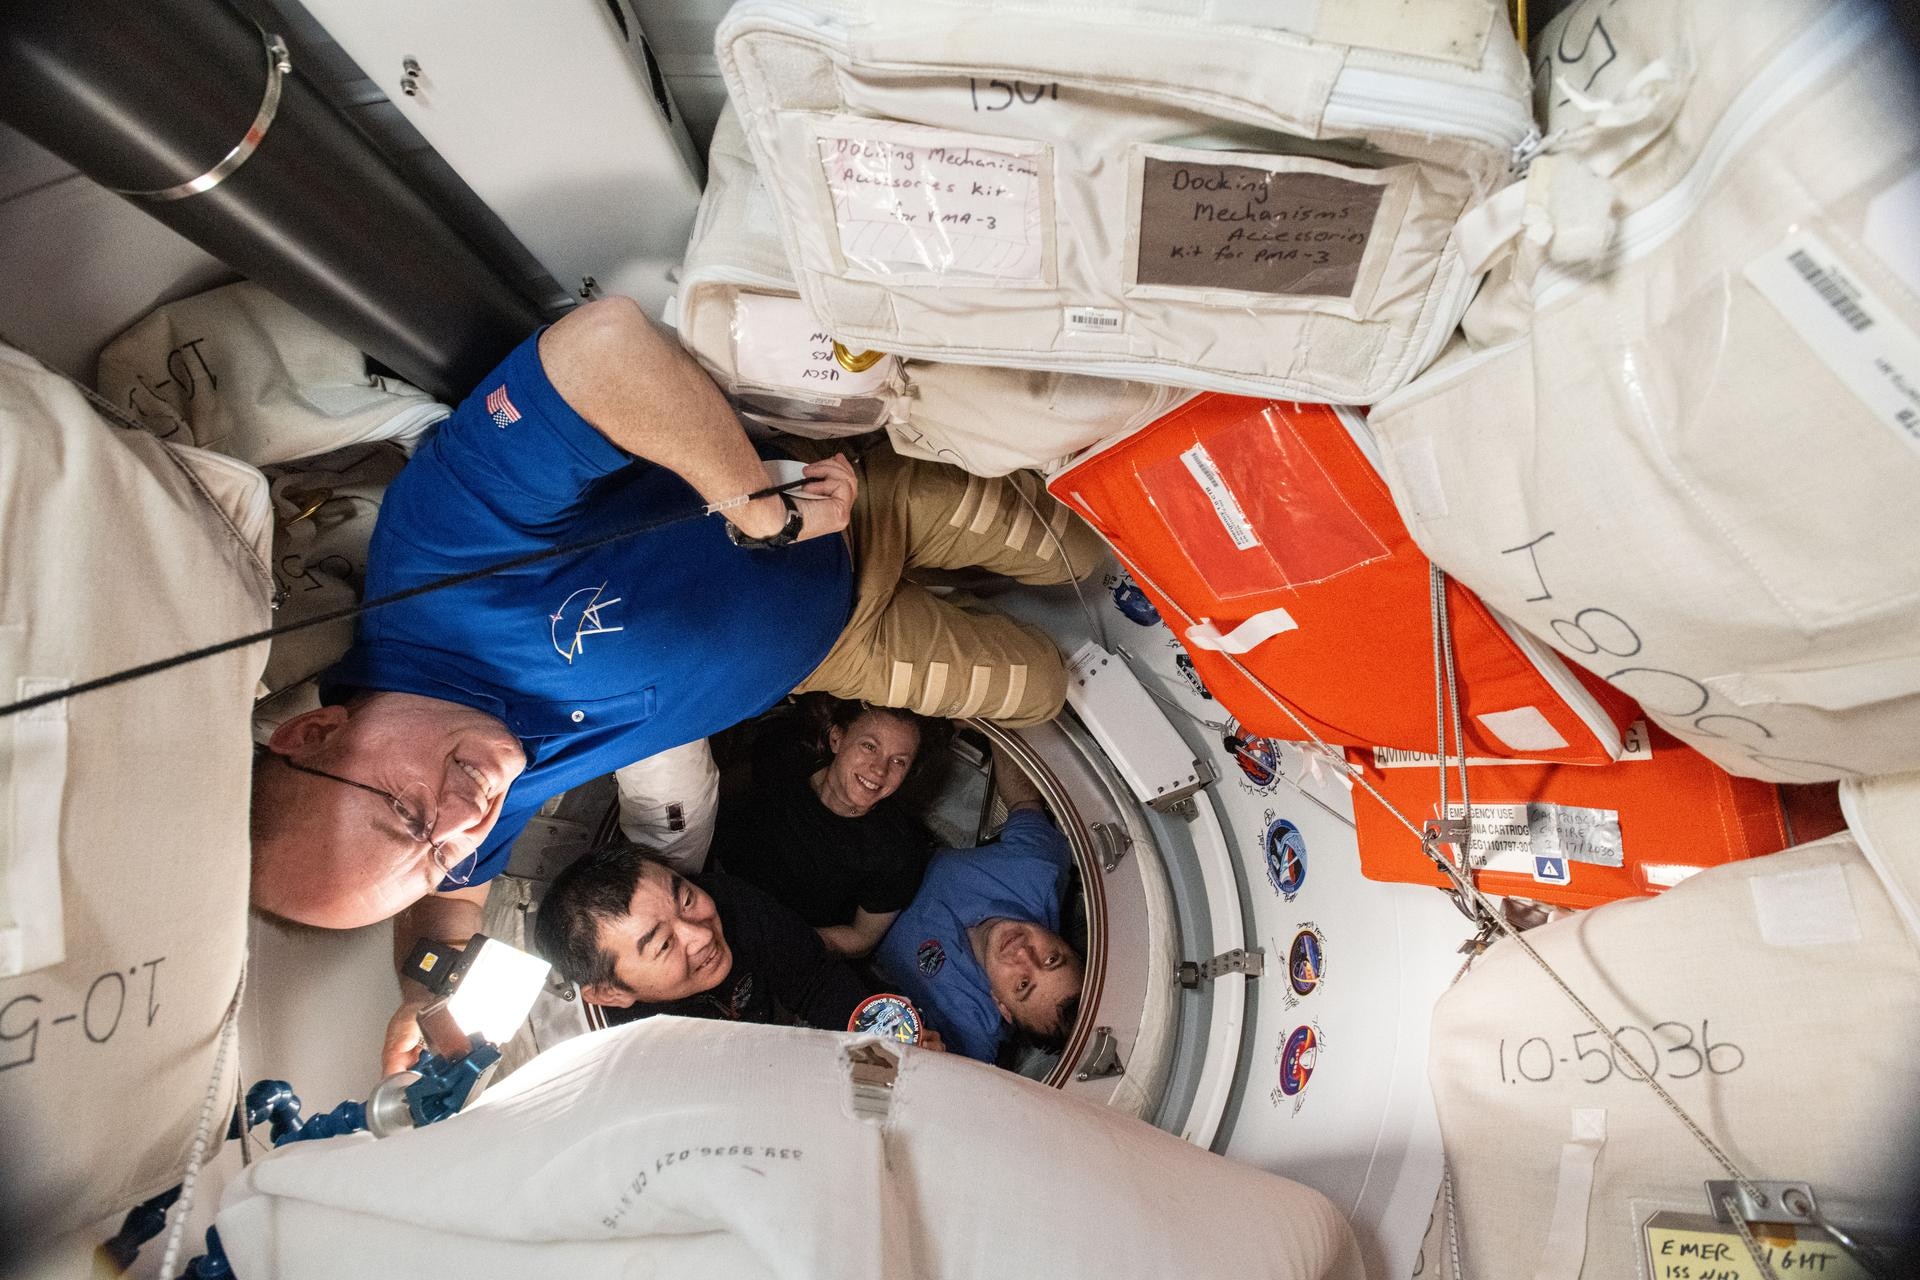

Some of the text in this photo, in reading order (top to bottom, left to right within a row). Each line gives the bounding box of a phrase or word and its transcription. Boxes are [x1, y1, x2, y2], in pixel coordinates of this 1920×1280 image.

[1172, 168, 1270, 202] Docking
[1193, 201, 1350, 223] Mechanisms
[1449, 807, 1515, 820] EMEGENCY USE
[1488, 824, 1530, 836] CARTRIDG
[1765, 1248, 1839, 1272] IGHT
